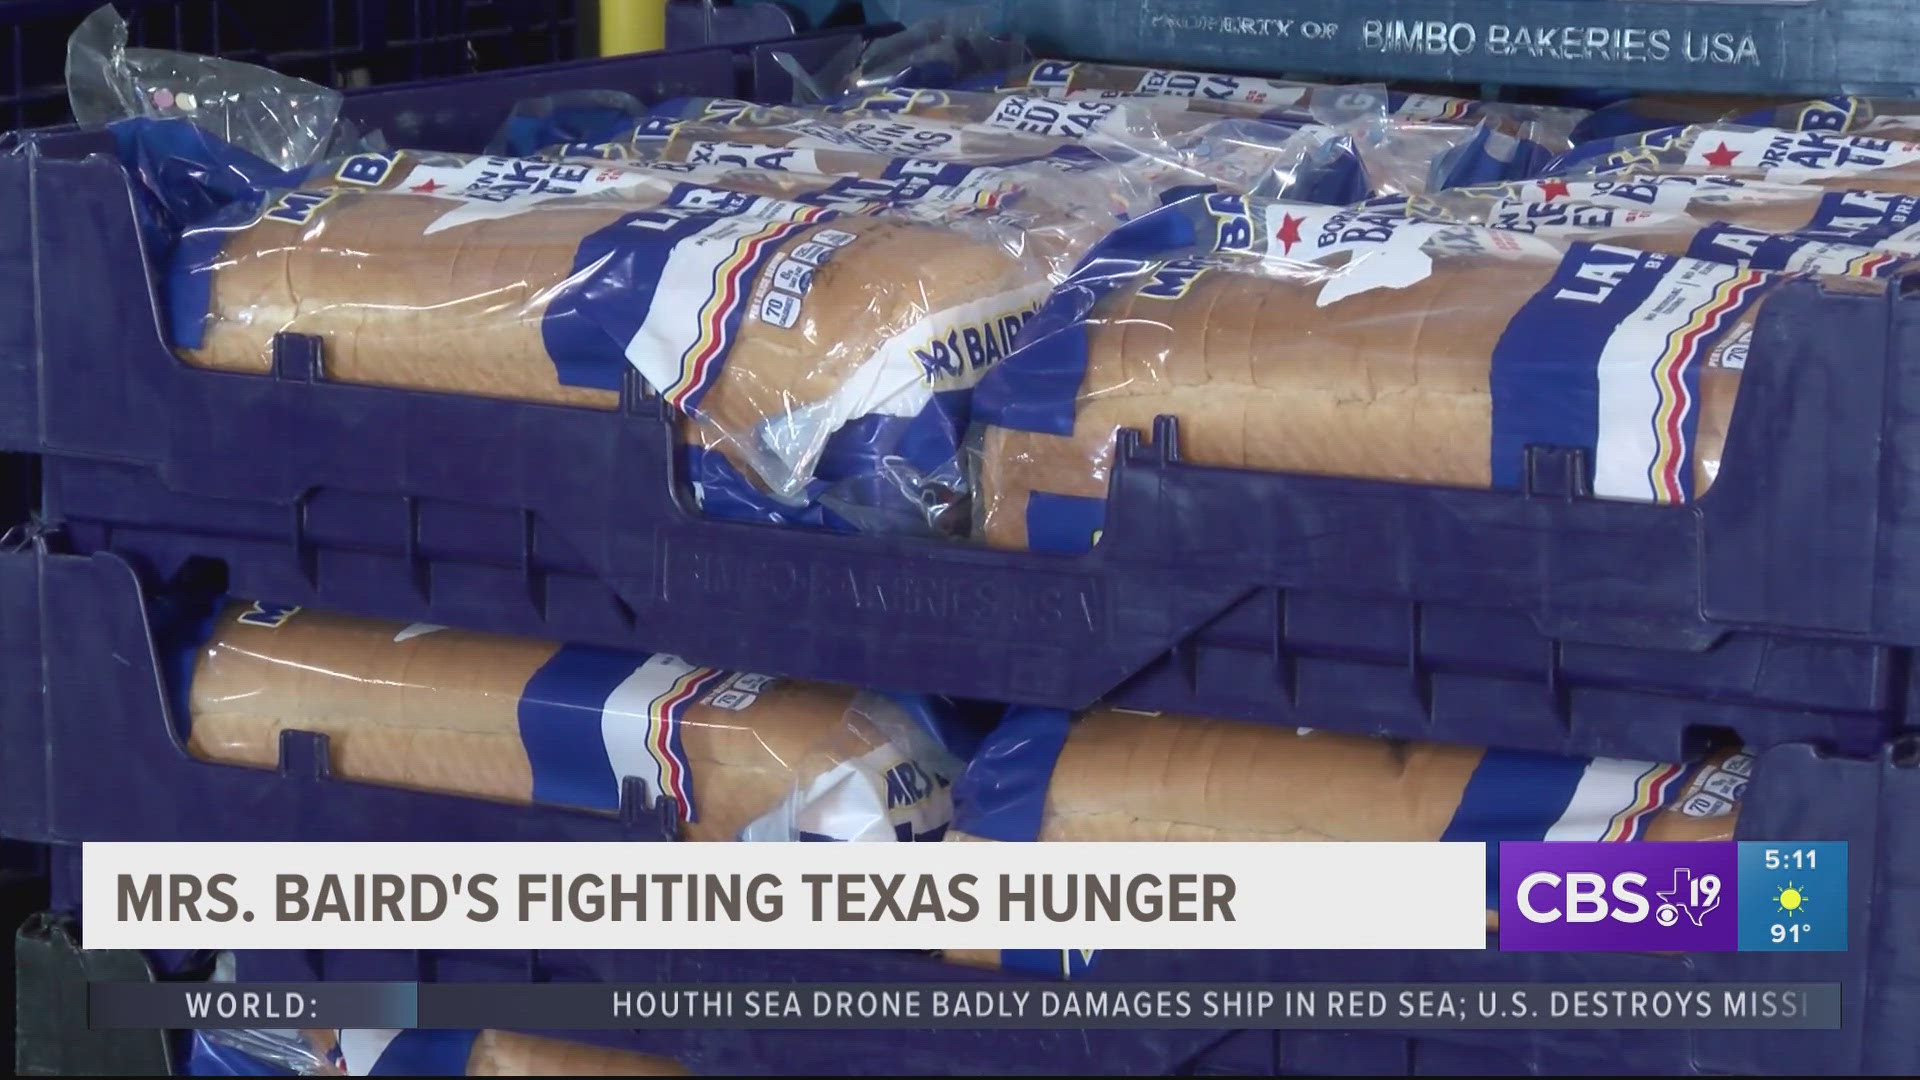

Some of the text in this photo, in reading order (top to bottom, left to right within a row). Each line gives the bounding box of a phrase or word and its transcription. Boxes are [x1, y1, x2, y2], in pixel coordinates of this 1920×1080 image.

[1300, 20, 1339, 40] OF
[1363, 18, 1477, 57] BIMBO
[1487, 23, 1671, 63] BAKERIES
[1683, 27, 1761, 67] USA
[765, 298, 783, 318] 70
[911, 329, 965, 384] MRS
[1689, 797, 1711, 814] 70
